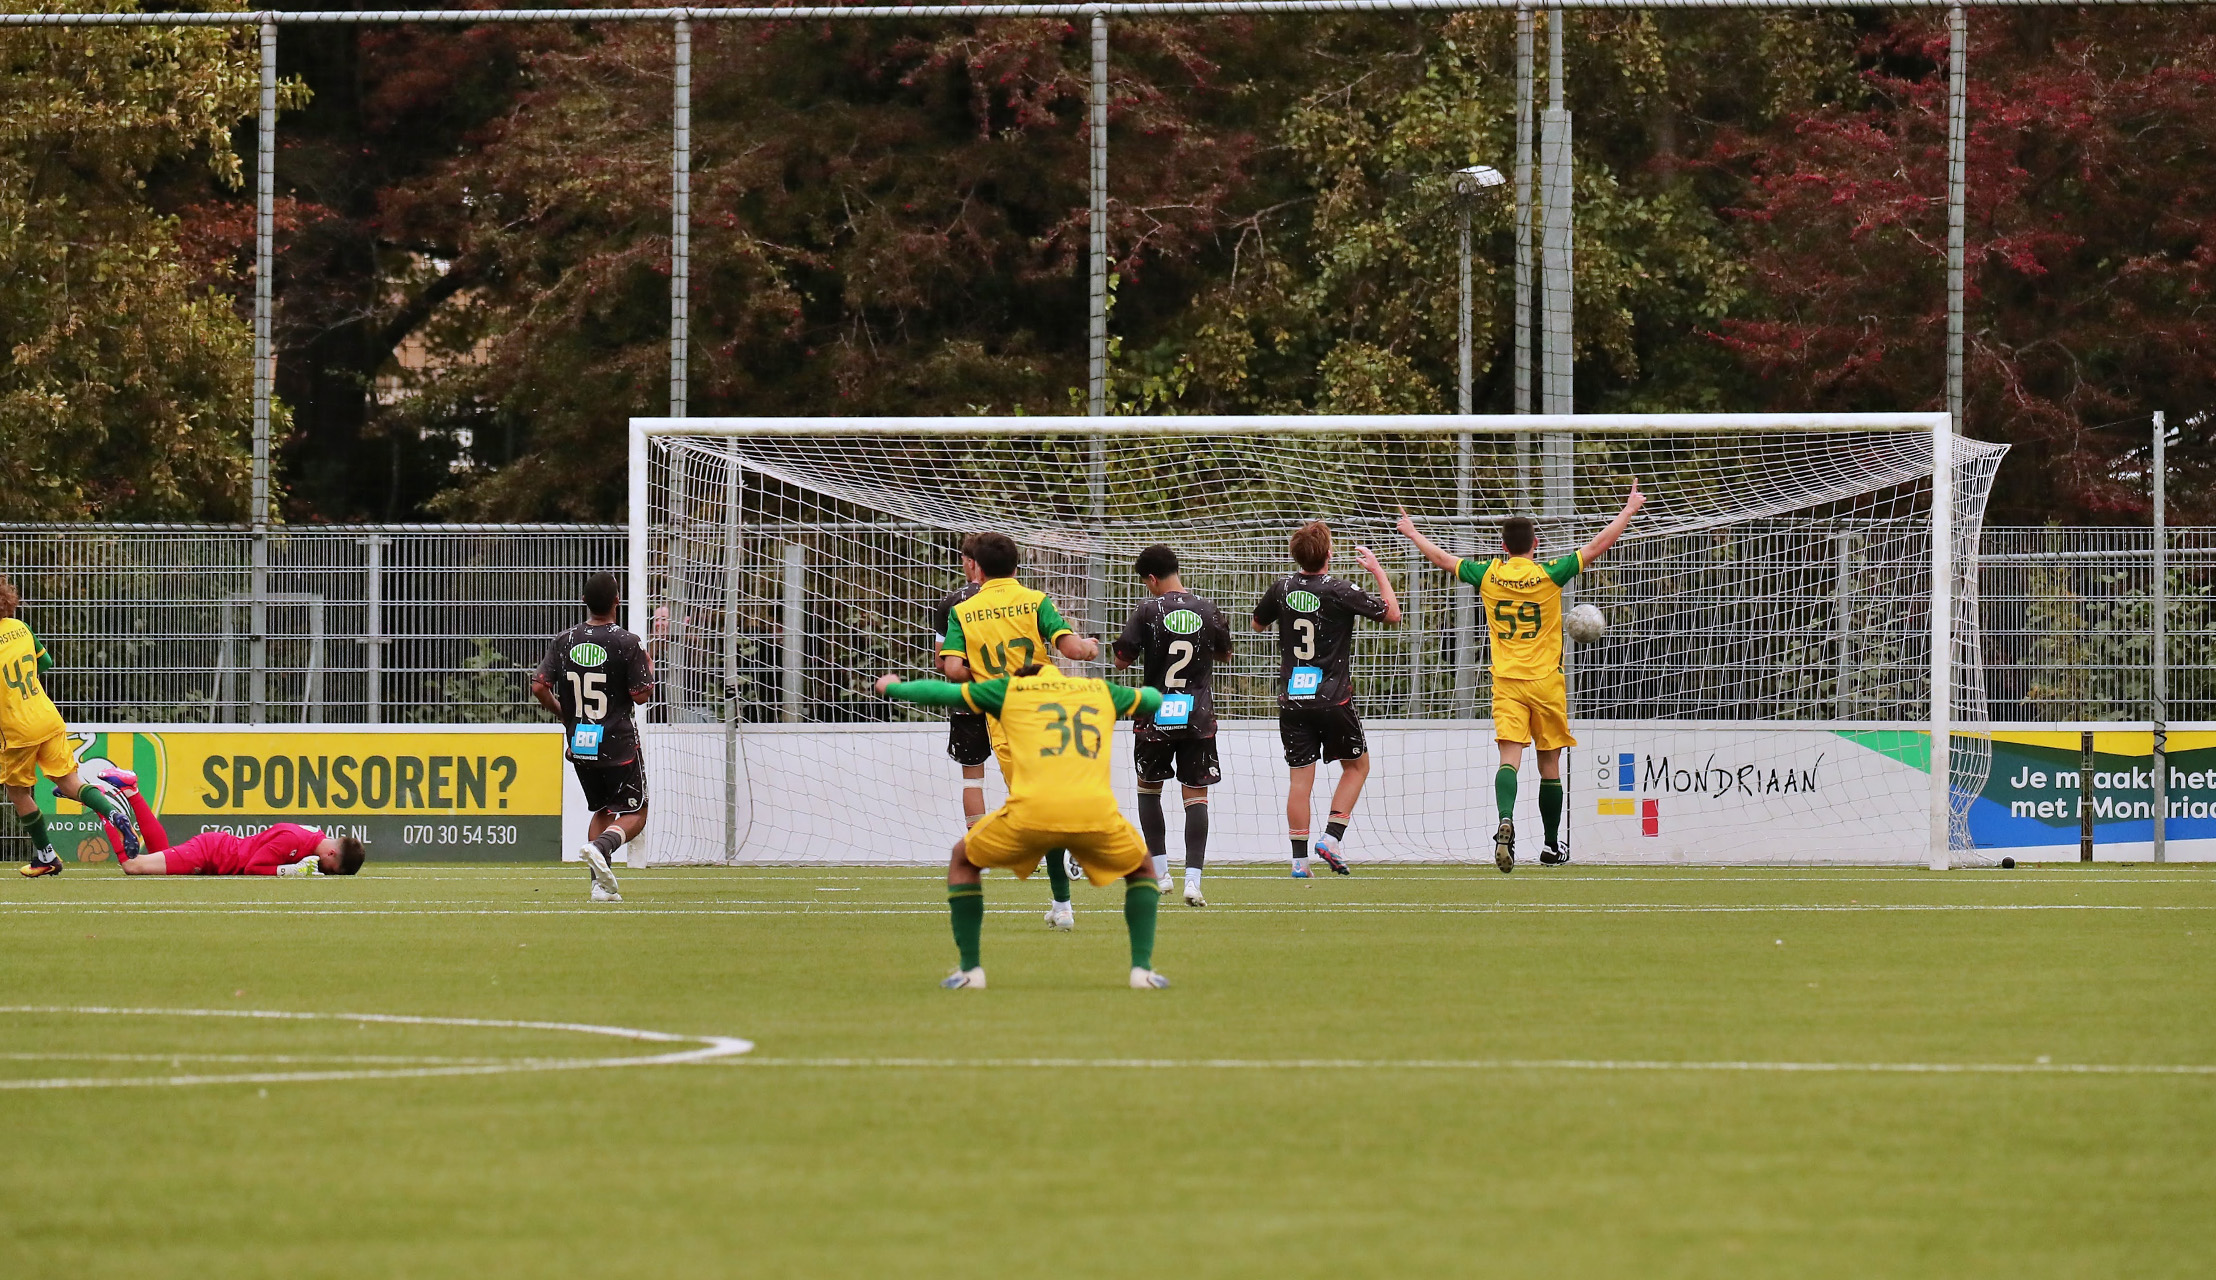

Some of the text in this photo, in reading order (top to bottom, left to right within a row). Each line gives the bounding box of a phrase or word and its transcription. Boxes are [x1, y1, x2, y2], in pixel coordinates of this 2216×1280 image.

[965, 602, 1039, 623] BIERSTEKER
[1494, 600, 1542, 639] 59
[1293, 618, 1315, 661] 3
[980, 637, 1035, 677] 47
[1164, 640, 1194, 688] 2
[567, 671, 608, 720] 15
[1293, 673, 1317, 689] BD
[1160, 701, 1187, 717] BD
[575, 731, 598, 747] BD
[1038, 703, 1102, 759] 36
[202, 755, 517, 809] SPONSOREN?
[1643, 752, 1825, 799] MONDRIAAN
[2010, 766, 2048, 789] Je
[2170, 766, 2216, 789] het
[2011, 797, 2069, 818] met
[47, 822, 103, 831] ADO DEN
[403, 825, 517, 844] 070 30 54 530
